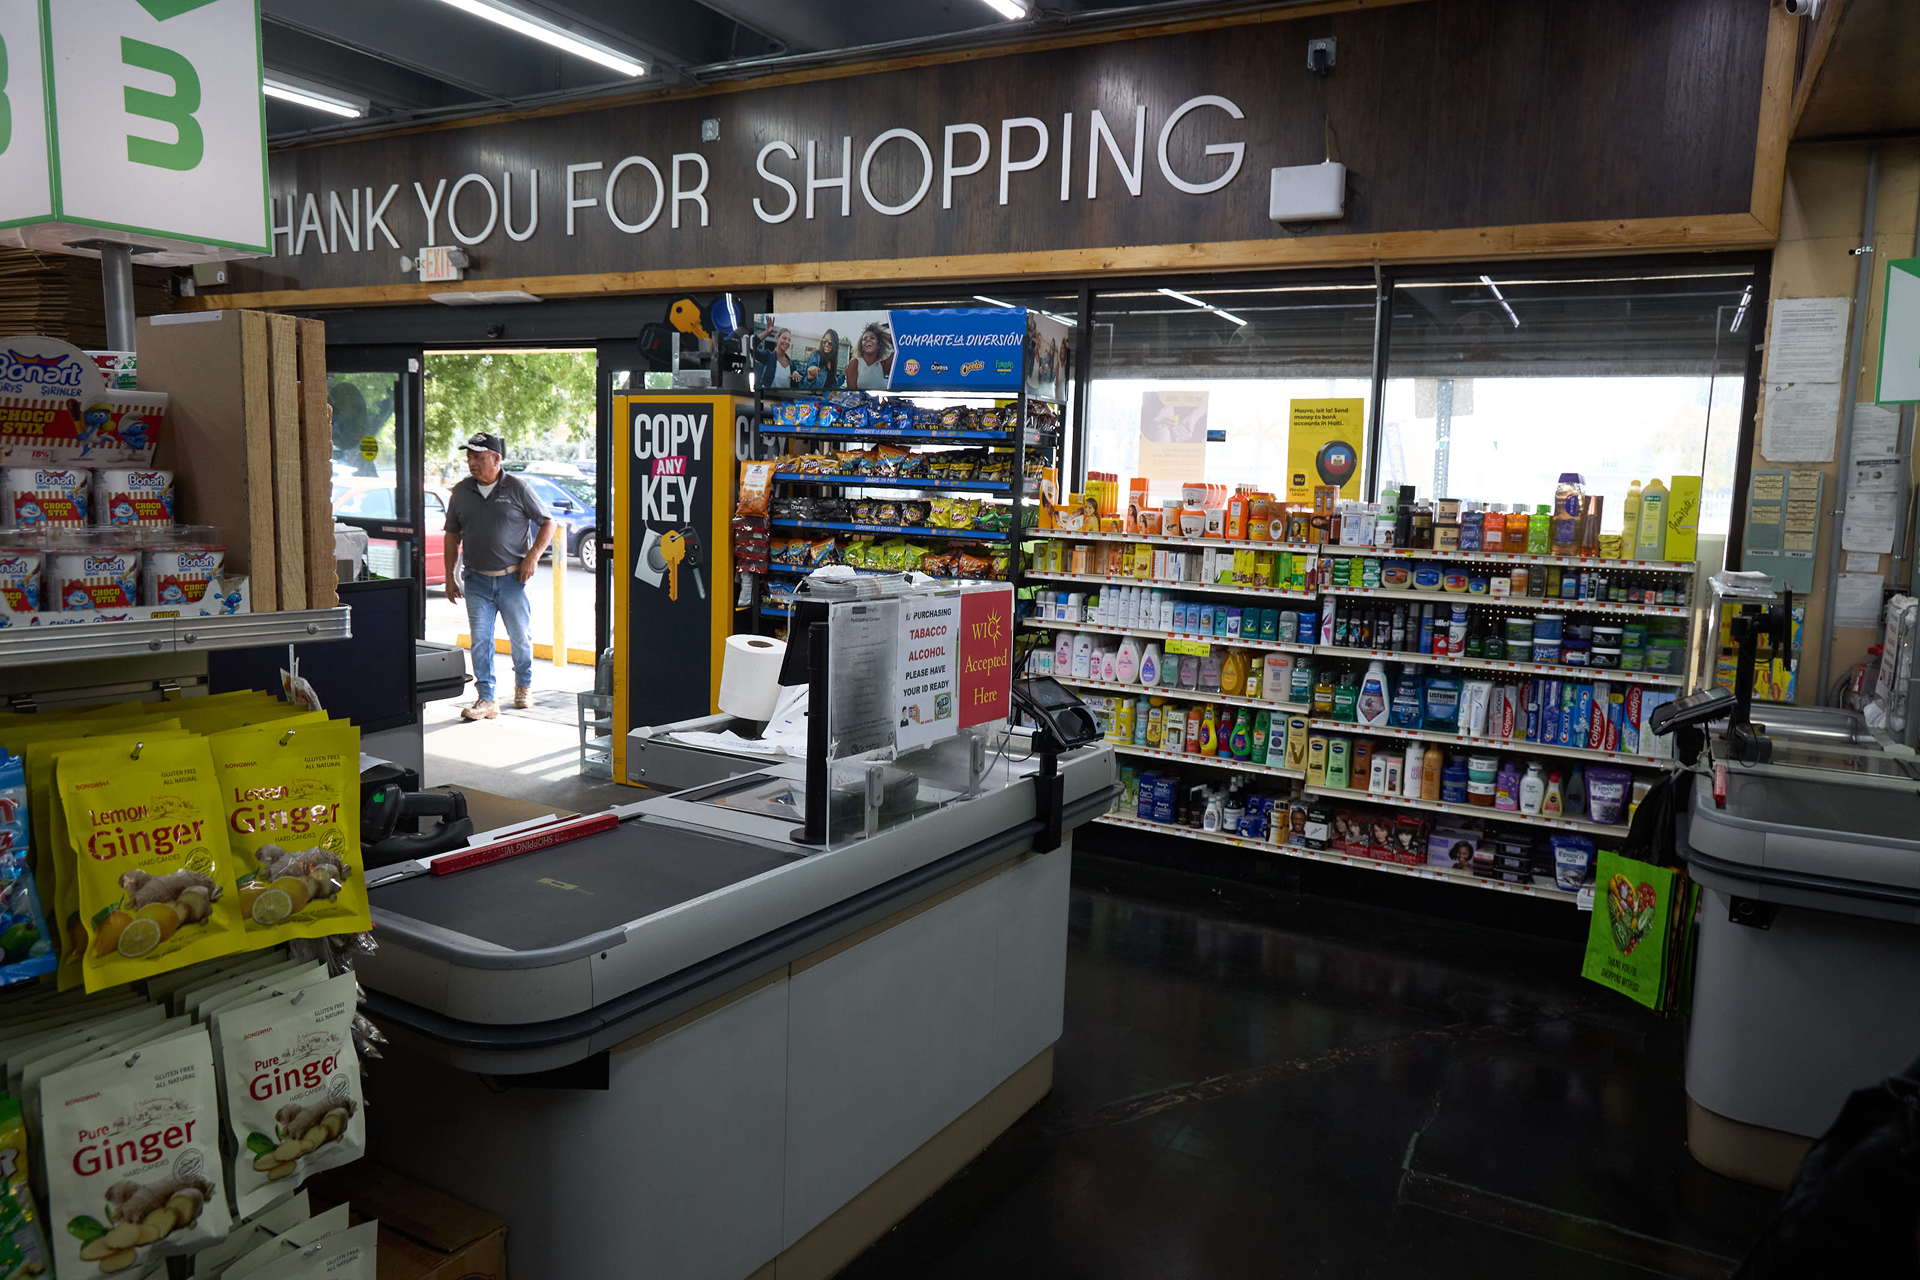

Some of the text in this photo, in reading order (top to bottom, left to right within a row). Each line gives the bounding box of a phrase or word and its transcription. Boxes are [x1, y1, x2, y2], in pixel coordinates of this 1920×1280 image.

[271, 94, 1247, 257] HANK YOU FOR SHOPPING
[426, 247, 452, 279] EXIT
[898, 333, 953, 347] COMPARTE
[965, 332, 1024, 347] DIVERSIÓN
[2, 422, 46, 435] STIX
[634, 413, 708, 461] COPY
[656, 457, 684, 475] ANY
[35, 471, 76, 487] Bonart
[128, 472, 165, 487] Bonart
[43, 502, 72, 510] CHOCO
[135, 502, 161, 510] CHOCO
[641, 474, 698, 523] KEY
[48, 509, 69, 517] STIX
[84, 557, 125, 571] Bonart
[178, 554, 214, 567] Bonart
[91, 588, 120, 597] CHOCO
[95, 595, 117, 604] STIX
[913, 608, 952, 620] PURCHASING
[909, 625, 947, 640] TABACCO
[972, 619, 998, 640] WIC
[908, 646, 946, 662] ALCOHOL
[964, 648, 1008, 676] Accepted
[905, 665, 946, 680] PLEASE HAVE
[903, 680, 950, 697] YOUR ID READY
[973, 687, 998, 706] Here
[1429, 691, 1456, 700] LISTERINE
[1628, 687, 1641, 723] Colgate
[1502, 707, 1513, 736] Colgate
[1560, 713, 1570, 743] Crest
[1590, 707, 1602, 747] Colgate
[1606, 722, 1616, 750] Colgate
[304, 755, 326, 763] GLUTEN
[316, 761, 341, 769] NATURAL
[161, 769, 181, 778] GLUTEN
[163, 776, 198, 786] ALL NATURAL
[234, 786, 289, 803] Lemon
[88, 805, 149, 827] Lemon
[230, 803, 340, 834] Ginger
[88, 819, 205, 861] Ginger
[275, 832, 316, 843] HARD CANDIES
[516, 835, 554, 853] SHOPPING
[138, 853, 181, 868] HARD CANDIES
[1558, 851, 1585, 861] Epsom
[314, 1001, 346, 1017] GLUTEN FREE
[315, 1009, 346, 1024] ALL NATURAL
[254, 1055, 279, 1072] Pure
[154, 1064, 195, 1081] GLUTEN FREE
[249, 1049, 341, 1101] Ginger
[155, 1073, 196, 1089] ALL NATURAL
[78, 1125, 110, 1143] Pure
[72, 1119, 197, 1177] Ginger
